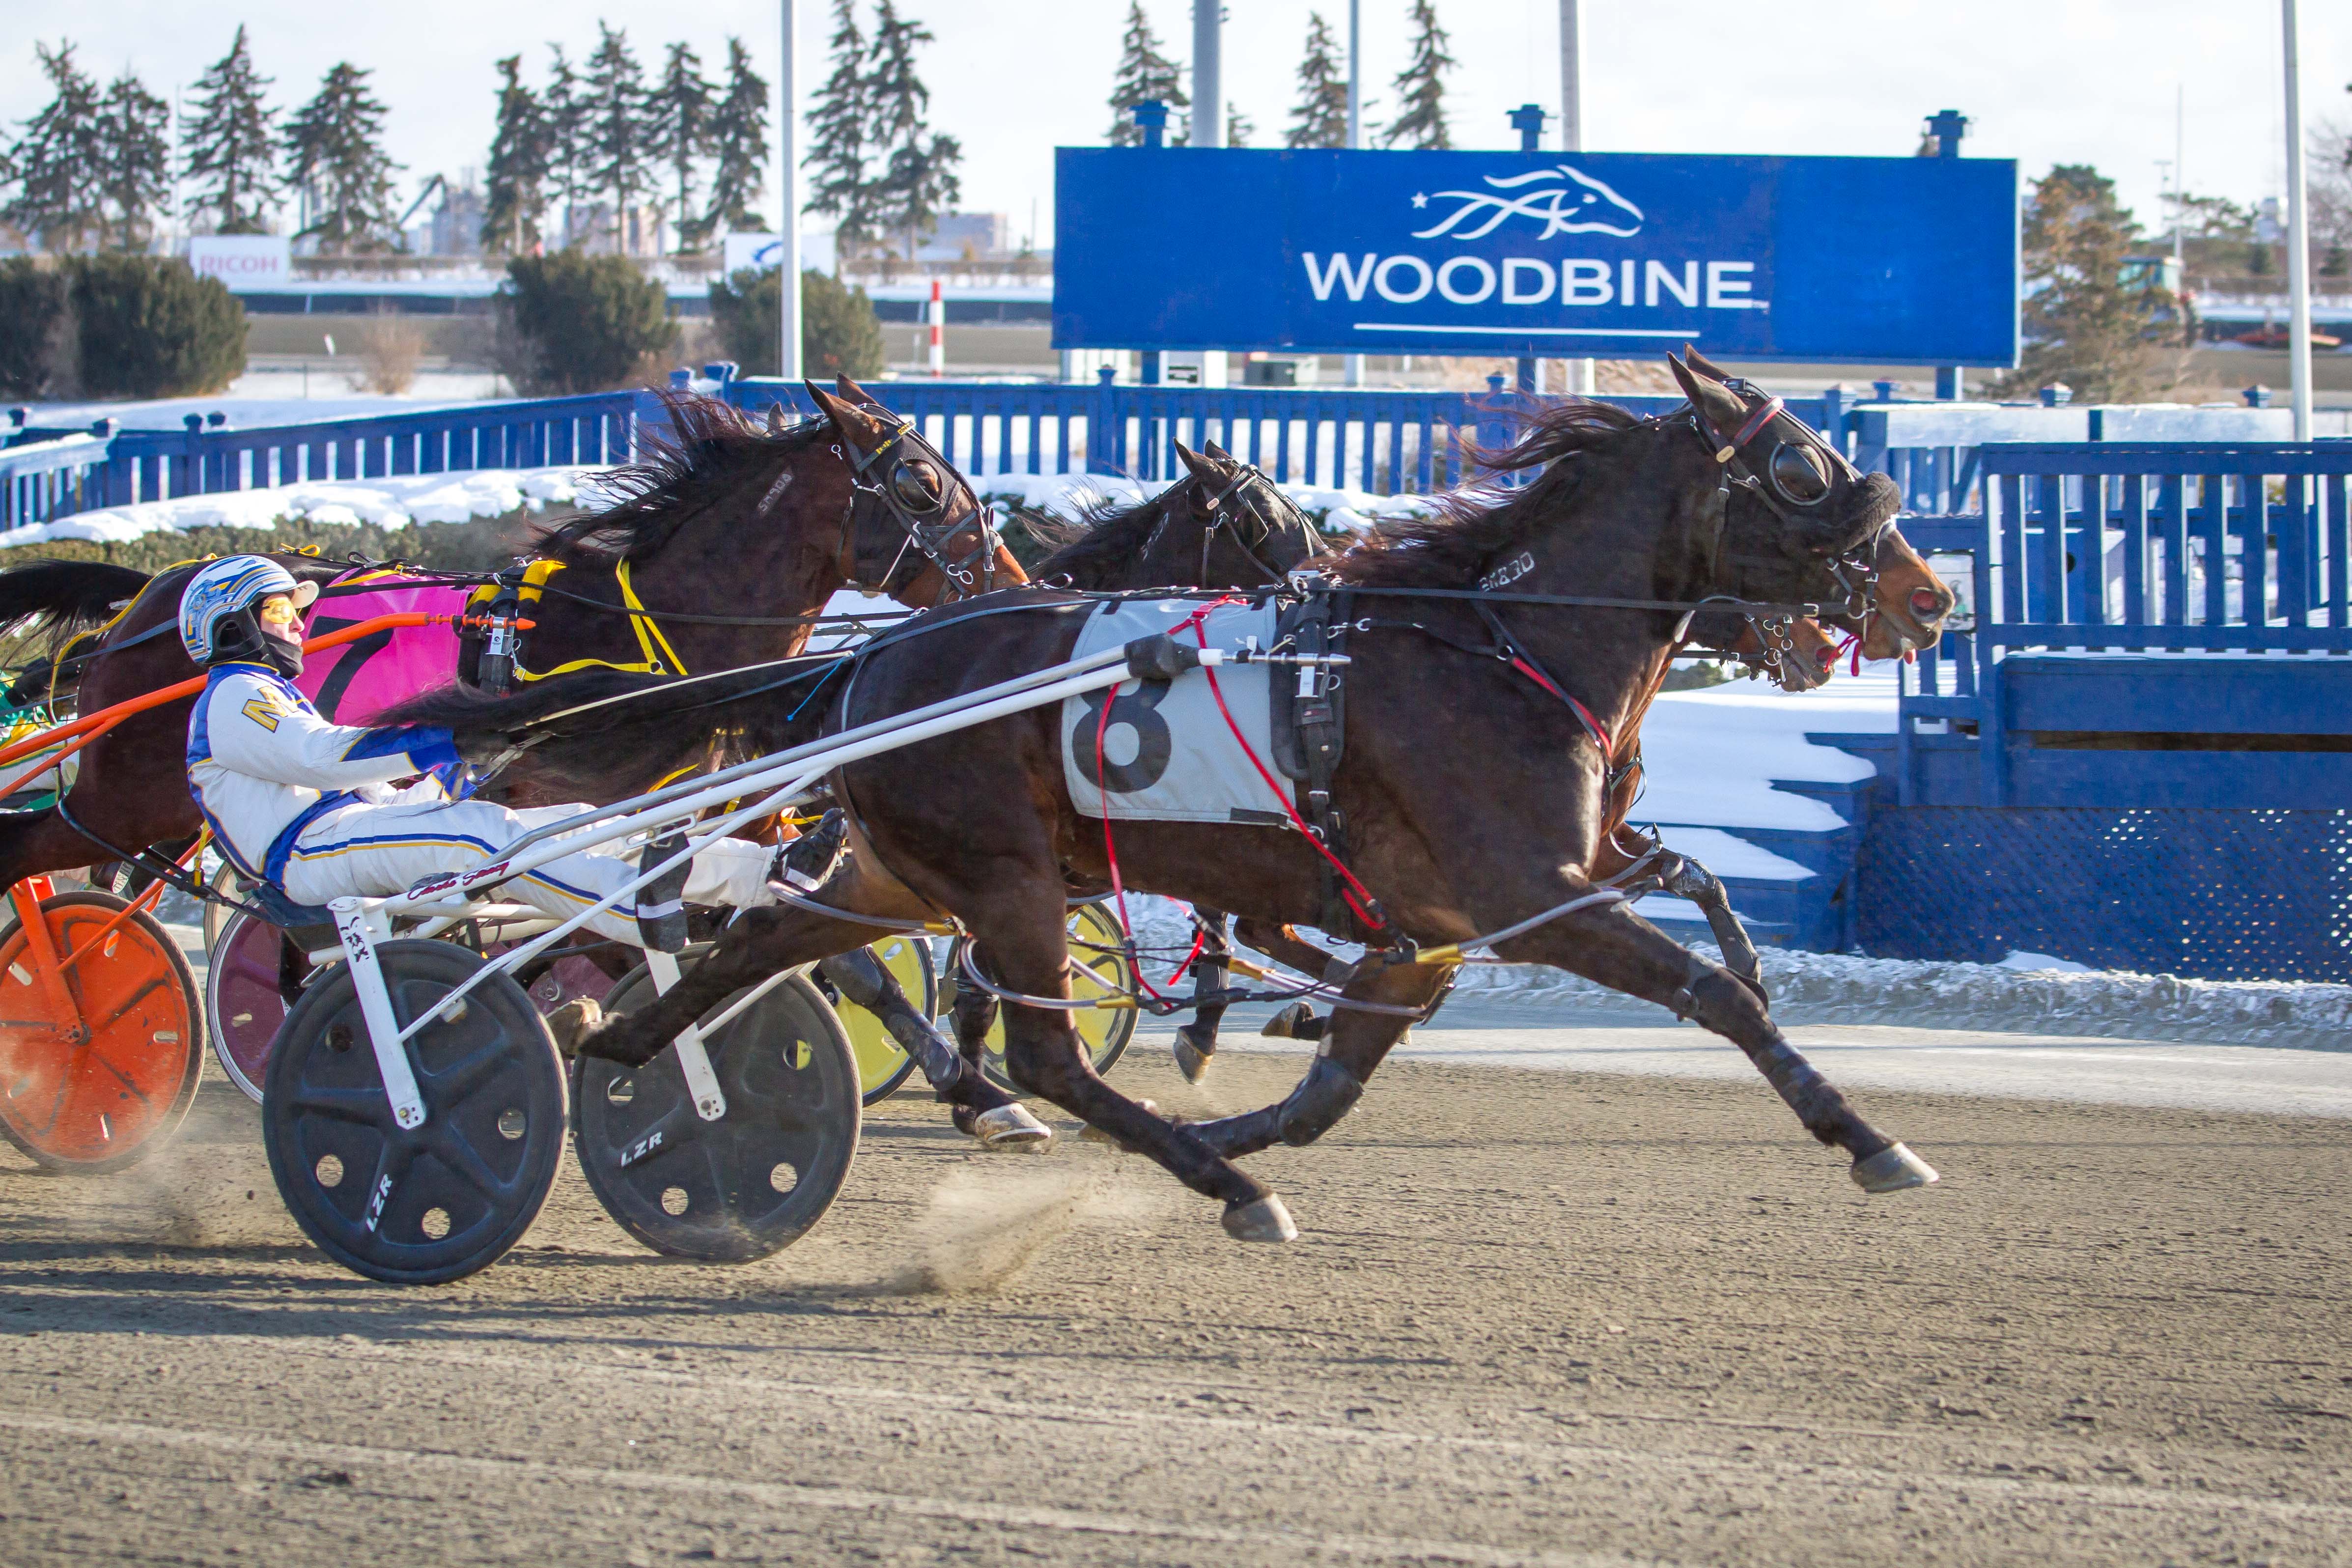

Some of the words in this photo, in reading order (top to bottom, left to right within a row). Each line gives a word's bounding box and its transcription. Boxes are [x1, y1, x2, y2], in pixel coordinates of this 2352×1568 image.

[200, 255, 279, 273] RICOH
[1302, 252, 1755, 308] WOODBINE
[309, 615, 394, 724] 7
[1072, 676, 1172, 793] 8
[621, 1131, 662, 1167] LZR
[366, 1173, 392, 1232] LZR
